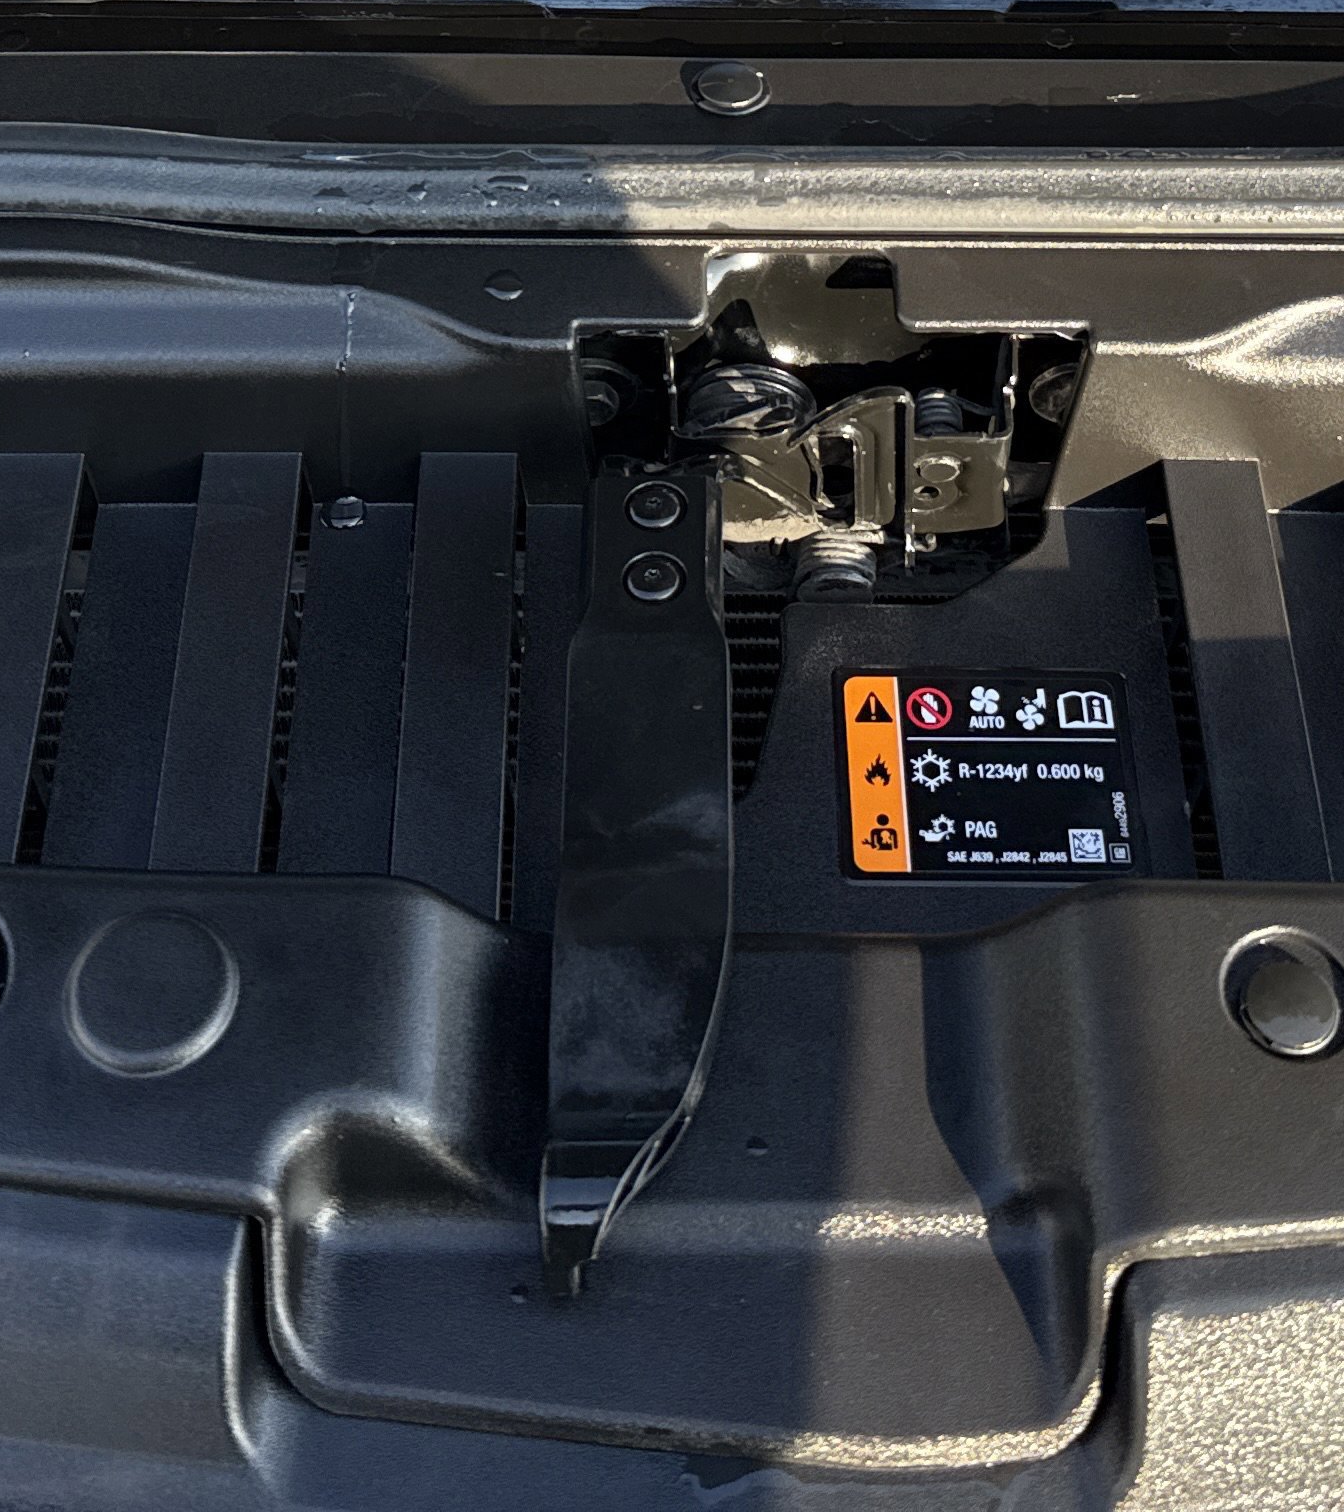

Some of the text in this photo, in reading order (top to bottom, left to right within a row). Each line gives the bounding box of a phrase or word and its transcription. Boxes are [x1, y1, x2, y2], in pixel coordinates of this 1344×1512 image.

[969, 715, 1004, 729] AUTO
[958, 763, 1104, 782] R-1234yf 0.600 kg
[965, 820, 997, 838] PAG
[947, 851, 967, 863] SAE
